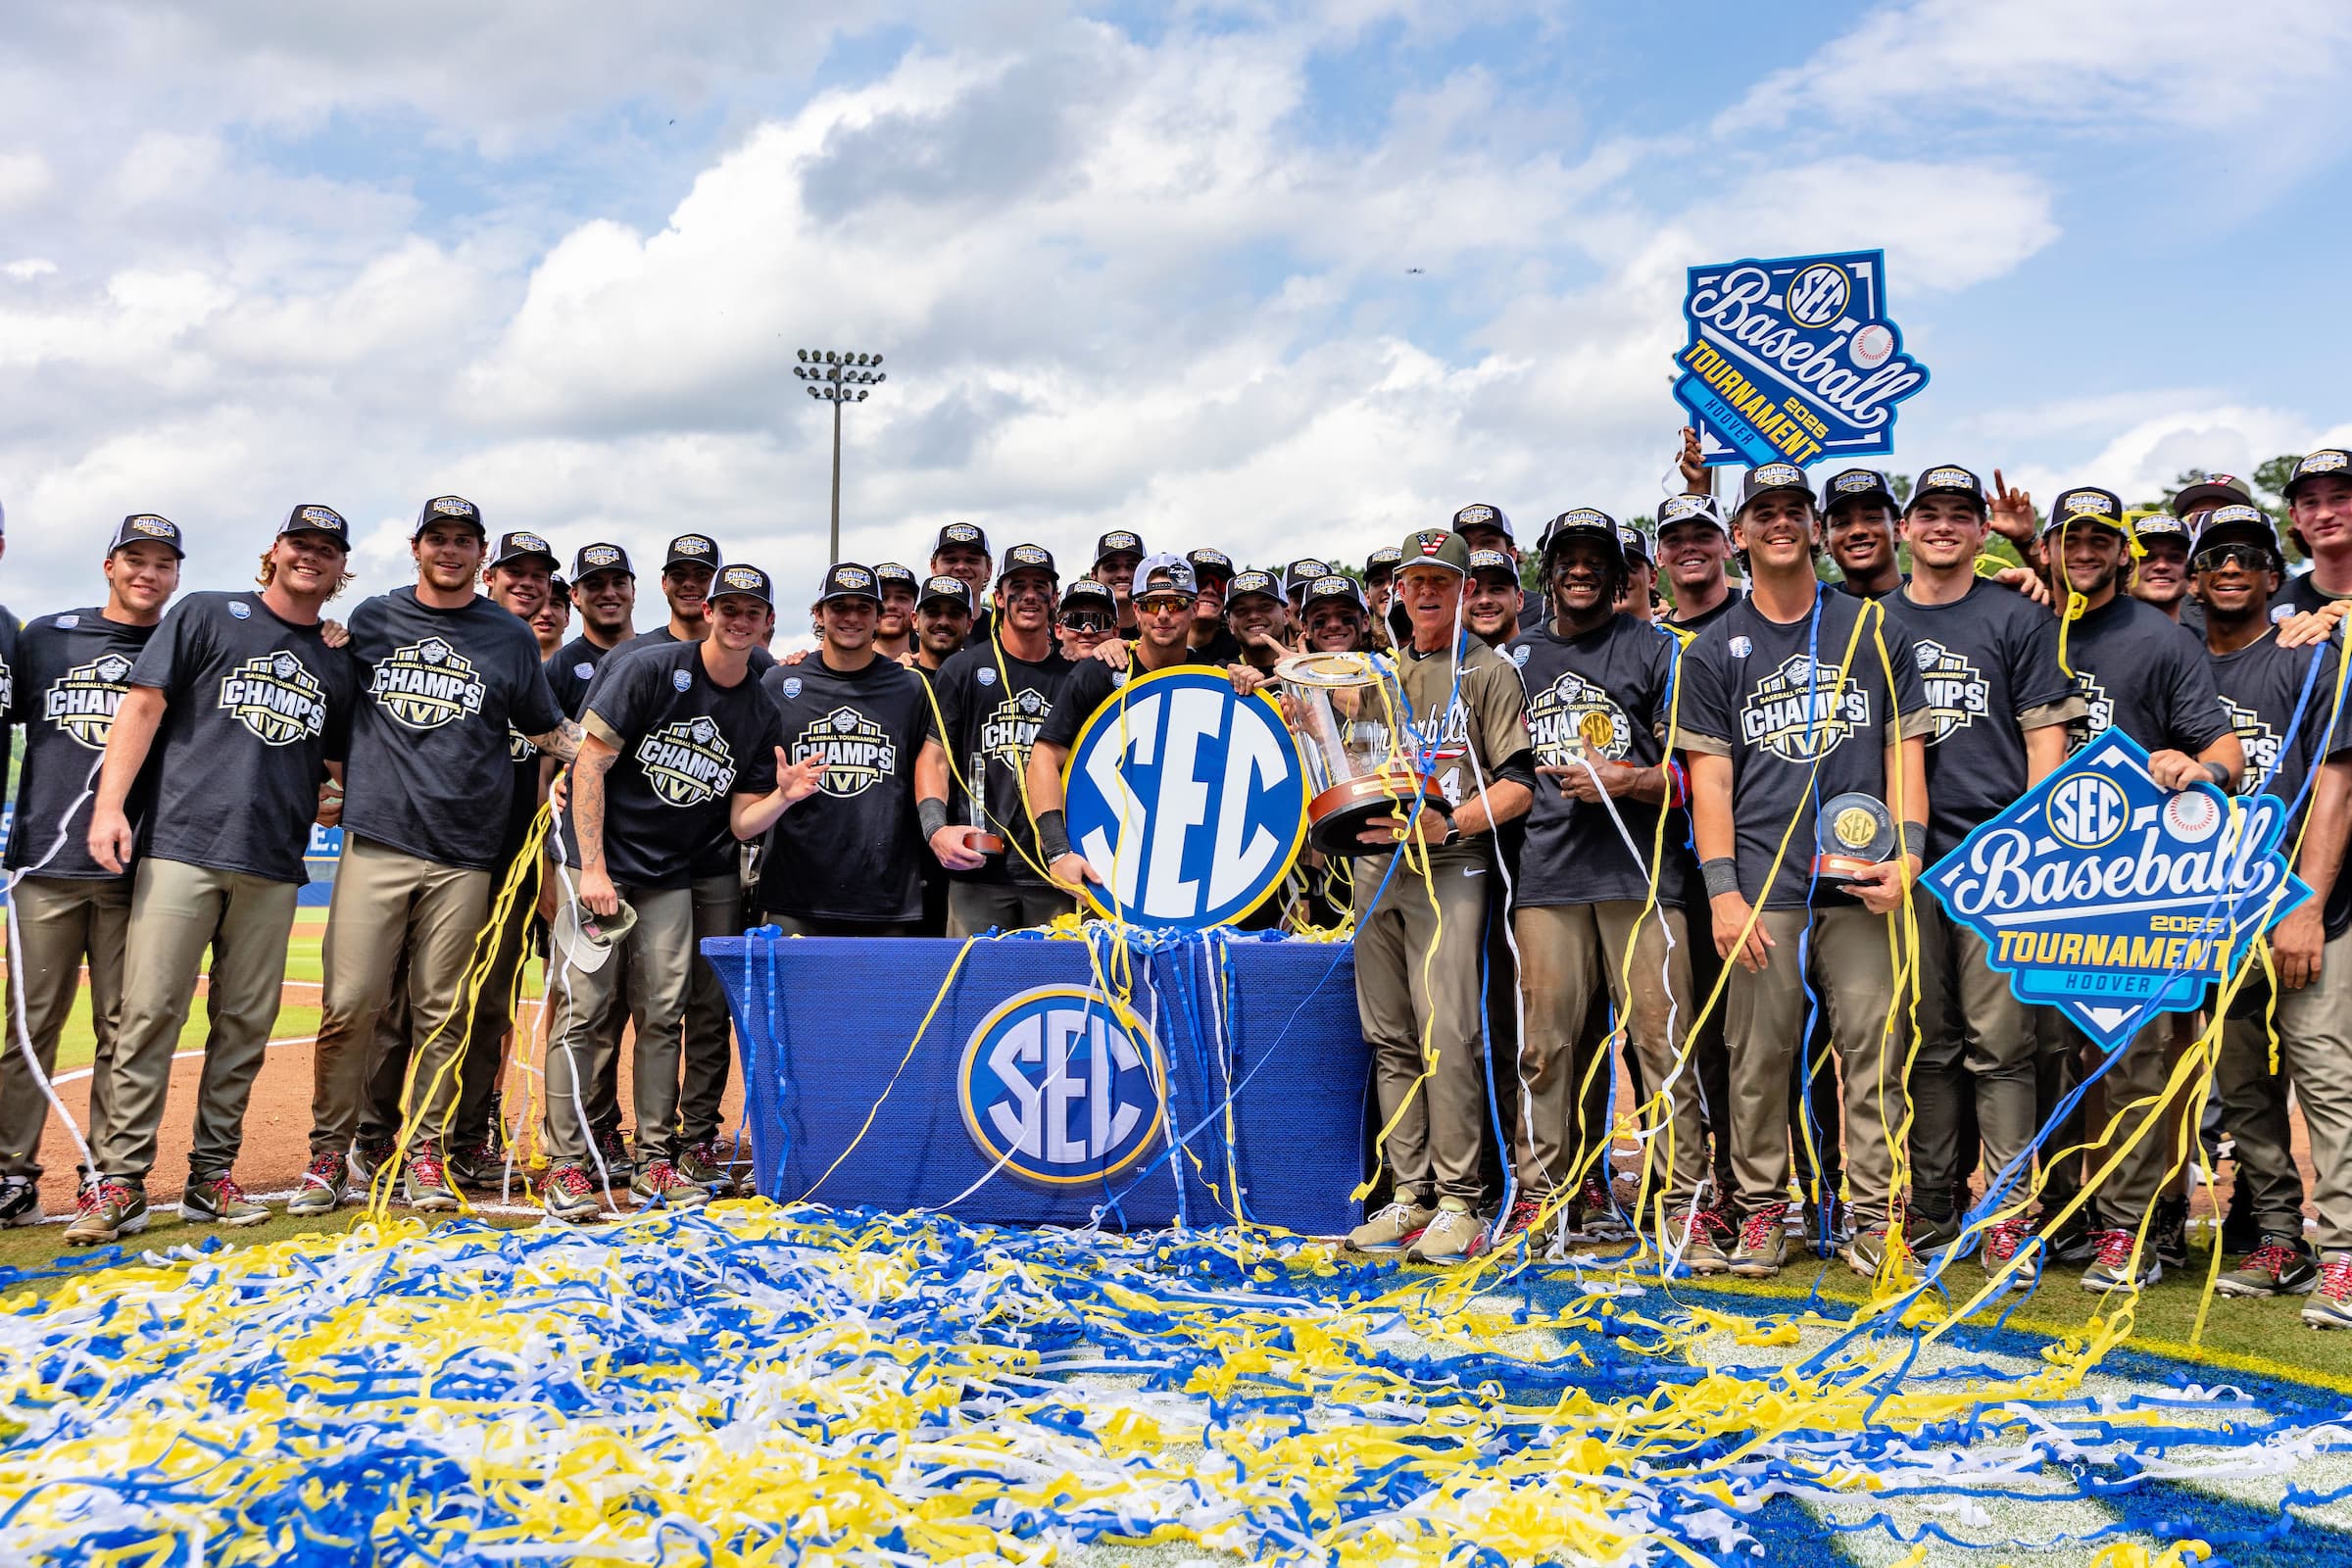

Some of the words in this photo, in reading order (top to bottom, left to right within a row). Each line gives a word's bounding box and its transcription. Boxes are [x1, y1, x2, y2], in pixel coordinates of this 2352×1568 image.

[1792, 268, 1845, 323] SEC
[1690, 267, 1922, 429] Baseball
[1685, 338, 1822, 464] TOURNAMENT
[1704, 399, 1756, 446] HOOVER
[305, 509, 340, 527] CHAMPS
[434, 501, 471, 514] CHAMPS
[1567, 512, 1605, 527] CHAMPS
[136, 517, 173, 535] CHAMPS
[586, 547, 619, 560] CHAMPS
[675, 537, 709, 550] CHAMPS
[727, 570, 761, 586] CHAMPS
[837, 570, 870, 585] CHAMPS
[391, 662, 423, 670] BASEBALL
[423, 664, 470, 679] TOURNAMENT
[244, 672, 275, 684] BASEBALL
[274, 679, 317, 700] TOURNAMENT
[375, 667, 481, 710] CHAMPS
[1759, 690, 1794, 704] BASEBALL
[224, 680, 325, 730] CHAMPS
[1744, 693, 1865, 739] CHAMPS
[664, 736, 691, 749] BASEBALL
[690, 742, 725, 764] TOURNAMENT
[838, 736, 881, 745] TOURNAMENT
[641, 740, 733, 792] CHAMPS
[795, 742, 894, 770] CHAMPS
[1081, 687, 1289, 919] SEC
[2053, 777, 2122, 843] SEC
[1840, 812, 1872, 842] SEC
[1954, 803, 2277, 915] Baseball
[1997, 931, 2233, 971] TOURNAMENT
[2065, 972, 2151, 994] HOOVER
[987, 1008, 1143, 1164] SEC
